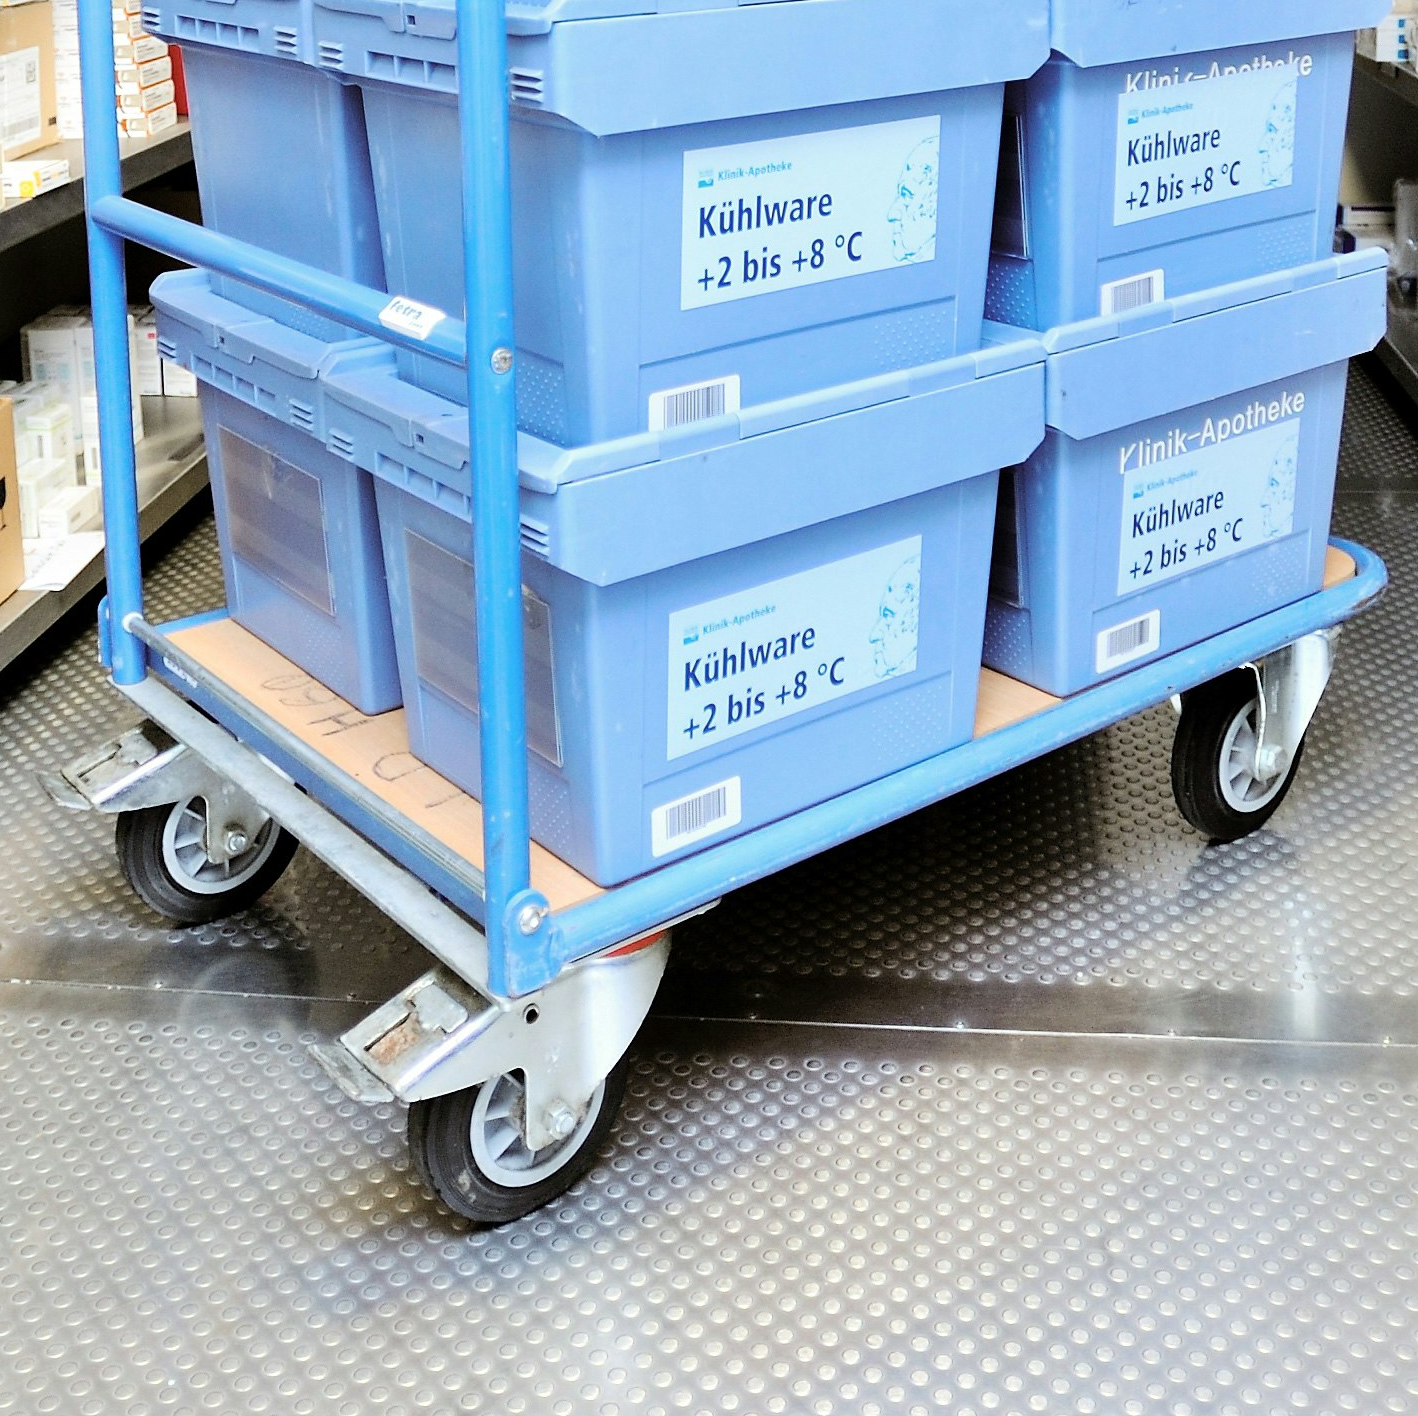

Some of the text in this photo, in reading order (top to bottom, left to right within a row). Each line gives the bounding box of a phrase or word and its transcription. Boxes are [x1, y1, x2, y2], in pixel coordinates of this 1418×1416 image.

[717, 161, 793, 182] Klinik-Apotheke
[1127, 129, 1221, 167] Kühlware
[1125, 160, 1241, 211] +2 bis +8 °C
[698, 192, 833, 239] Kühlware
[697, 231, 863, 292] +2 bis +8 °C
[1131, 490, 1225, 539] Kühlware
[1129, 517, 1244, 580] +2 bis +8 °C
[702, 604, 777, 635] Klinik-Apotheke
[684, 627, 816, 692] Kühlware
[683, 656, 845, 740] +2 bis +8 °C
